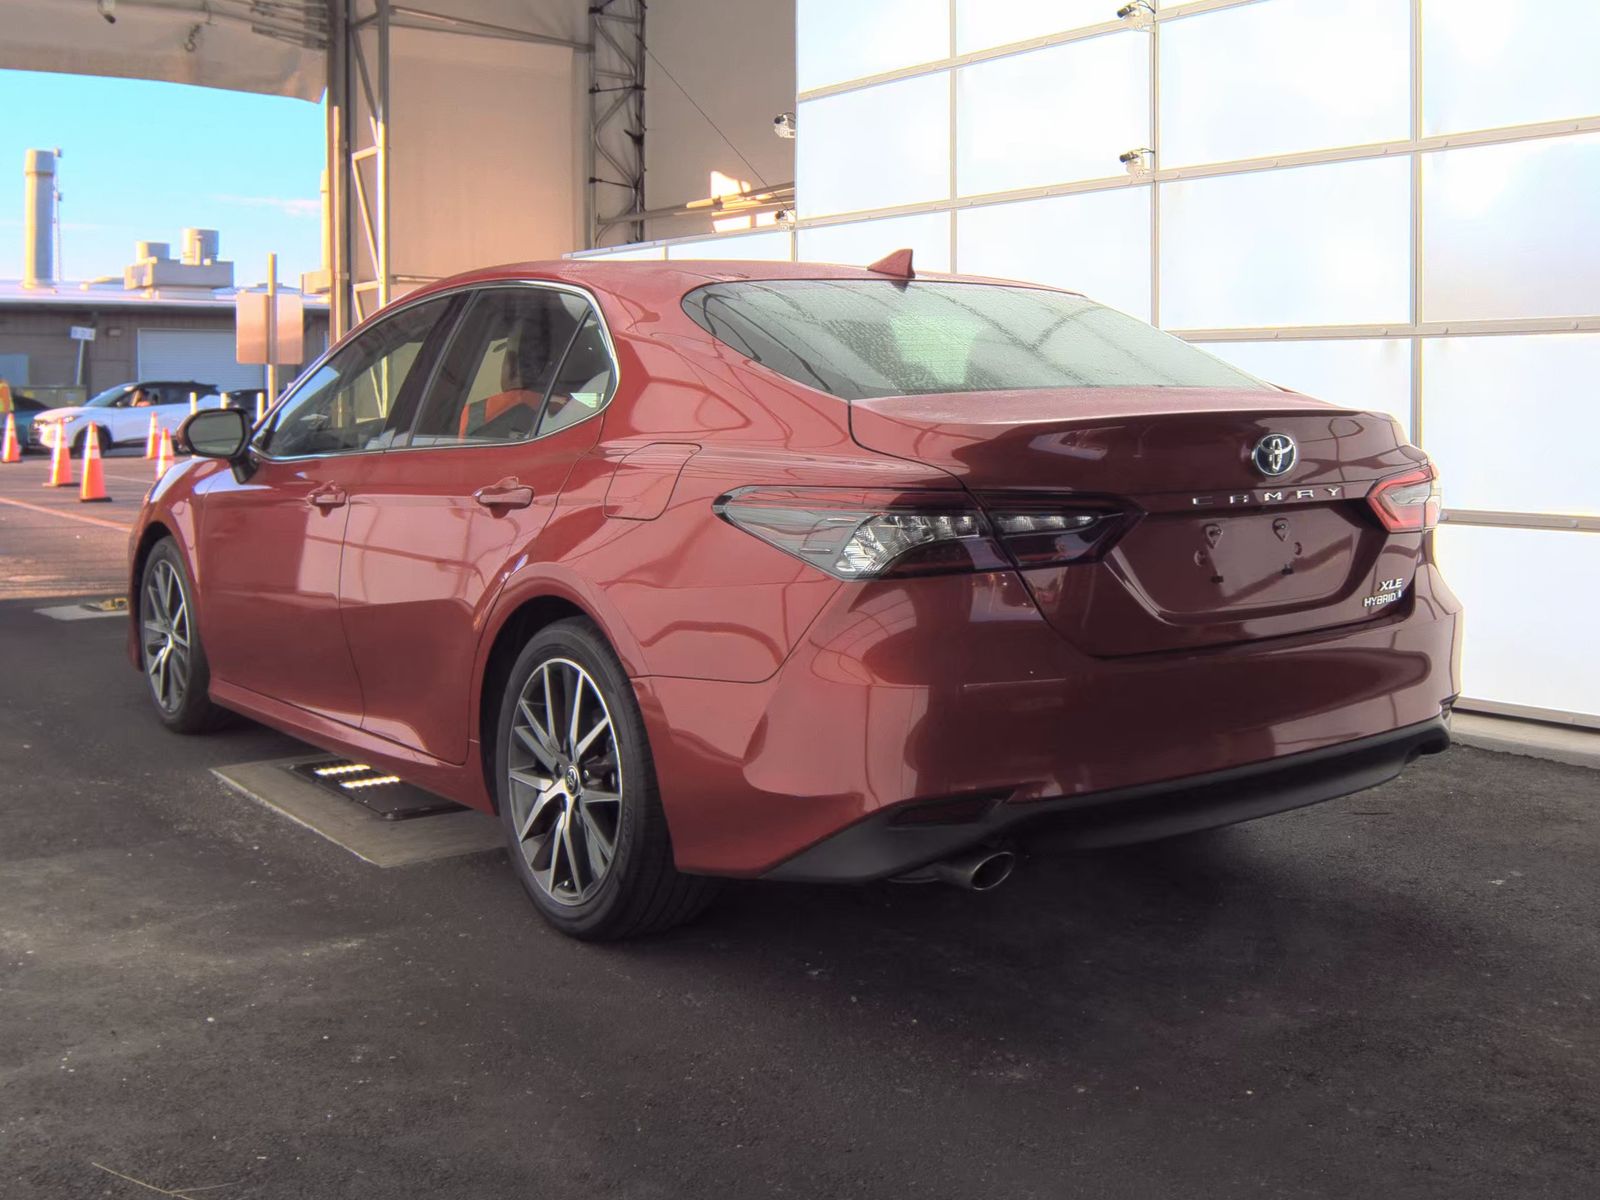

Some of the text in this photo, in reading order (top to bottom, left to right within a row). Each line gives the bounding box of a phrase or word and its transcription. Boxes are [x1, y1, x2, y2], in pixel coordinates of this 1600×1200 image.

[1192, 486, 1342, 506] CAMRY
[1378, 577, 1404, 592] XLE
[1363, 592, 1397, 607] HYBRID
